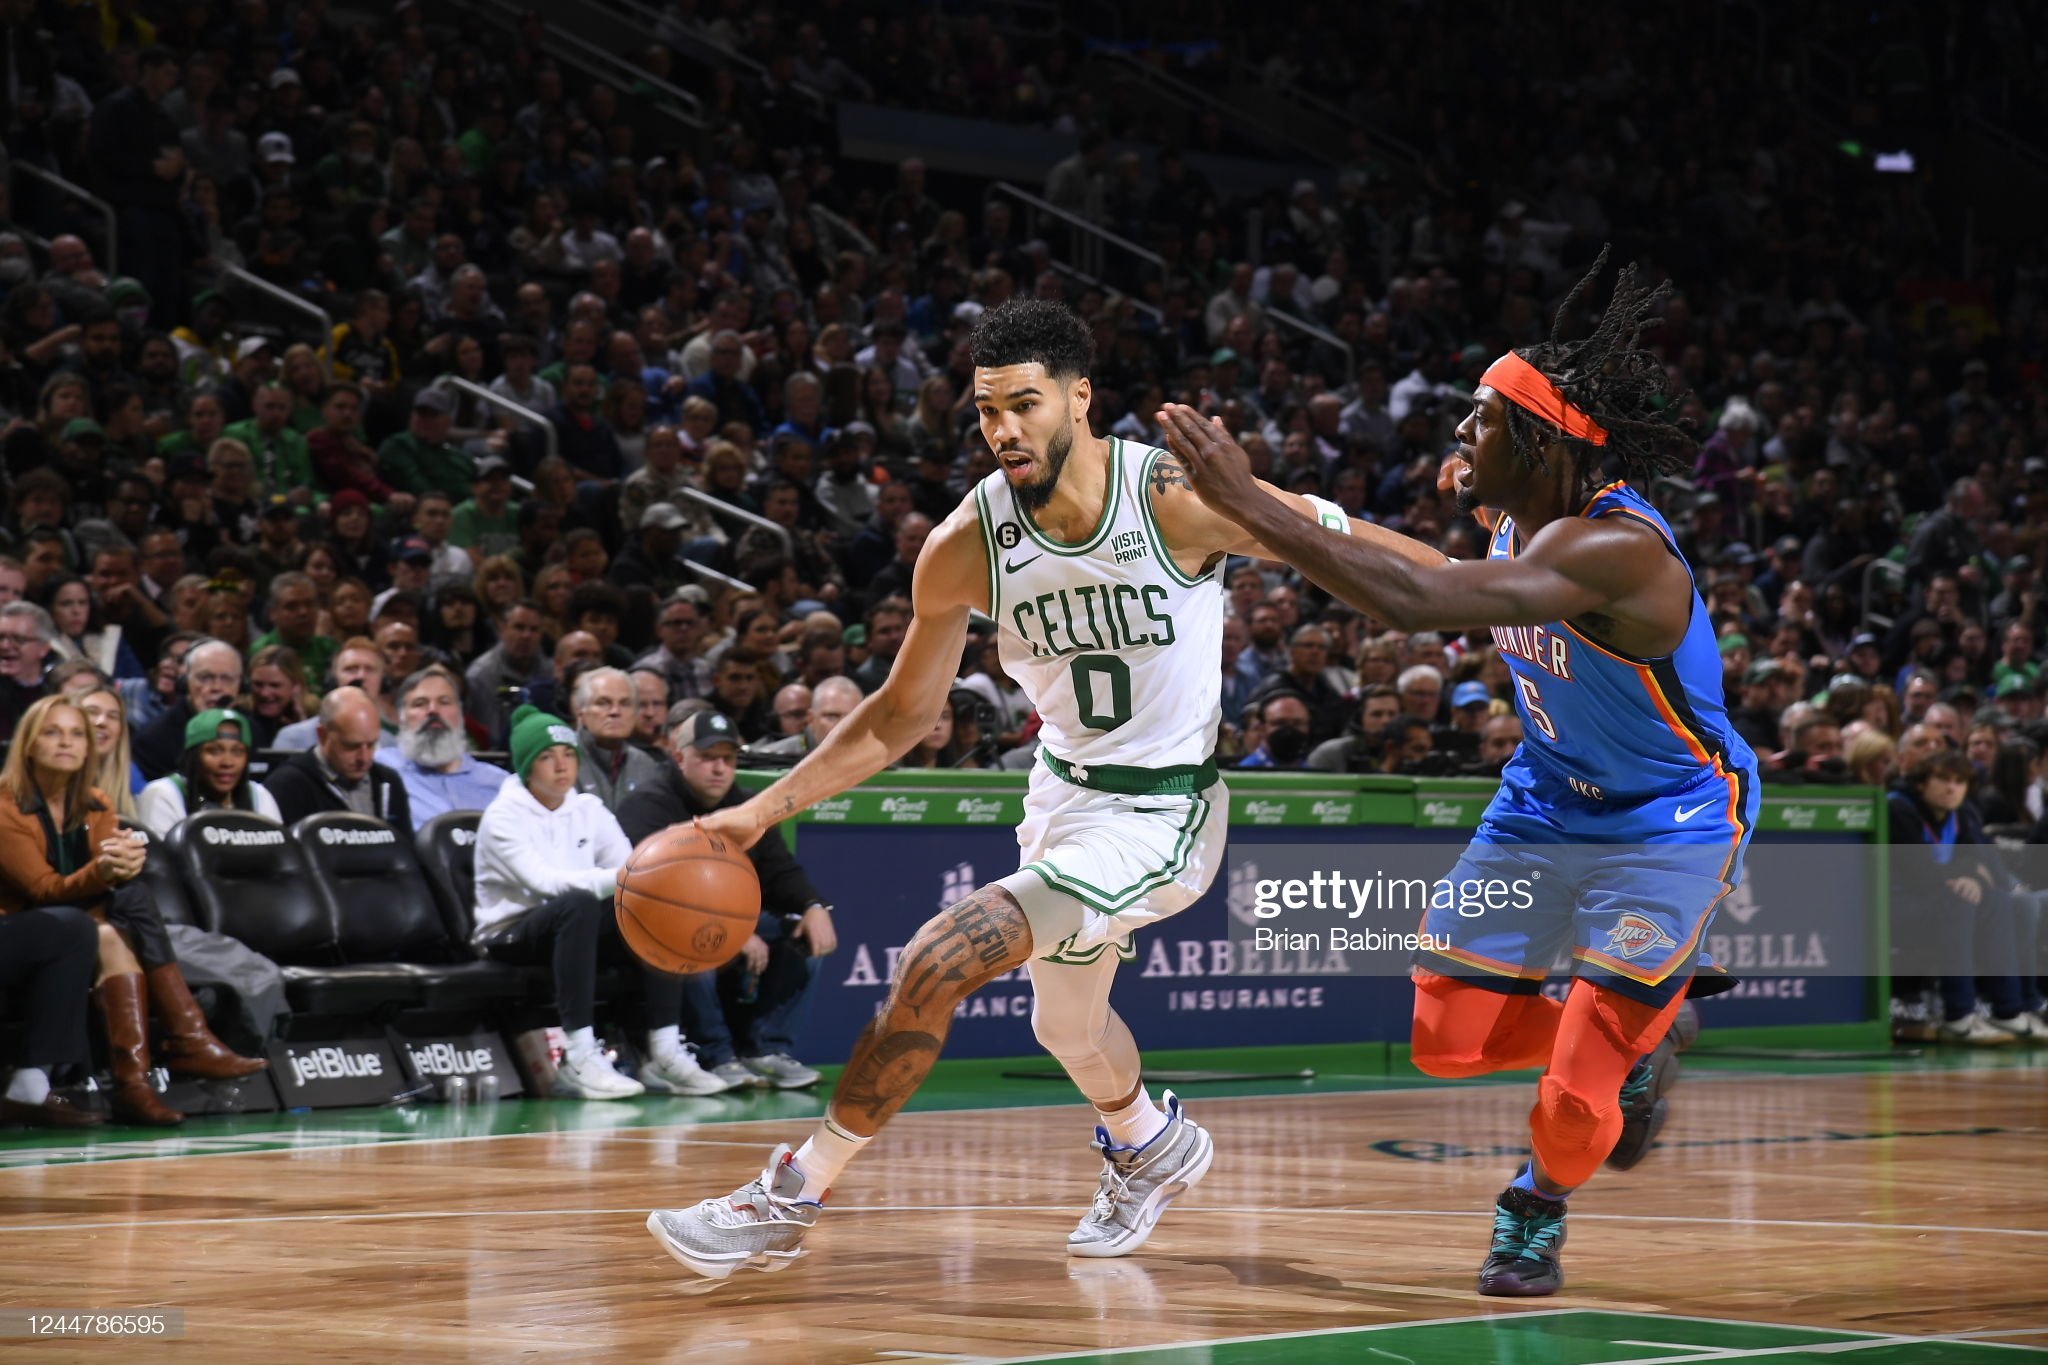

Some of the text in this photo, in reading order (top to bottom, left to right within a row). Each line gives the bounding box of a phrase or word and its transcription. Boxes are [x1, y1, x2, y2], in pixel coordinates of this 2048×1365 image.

[1002, 525, 1016, 547] 6
[1111, 530, 1145, 551] VISTA
[1115, 546, 1149, 565] PRINT
[1012, 583, 1176, 657] CELTICS
[1489, 625, 1572, 681] UNDER
[1070, 654, 1133, 733] 0
[1516, 672, 1557, 741] 5
[1569, 776, 1604, 801] OKC
[219, 827, 285, 847] Putnam
[333, 826, 396, 846] Putnam
[1612, 925, 1652, 945] OKC
[1709, 932, 1828, 968] BELLA
[1141, 938, 1351, 979] ARBELLA
[1168, 987, 1325, 1012] INSURANCE
[287, 1047, 384, 1087] jetBlue
[405, 1043, 495, 1078] jetBlue
